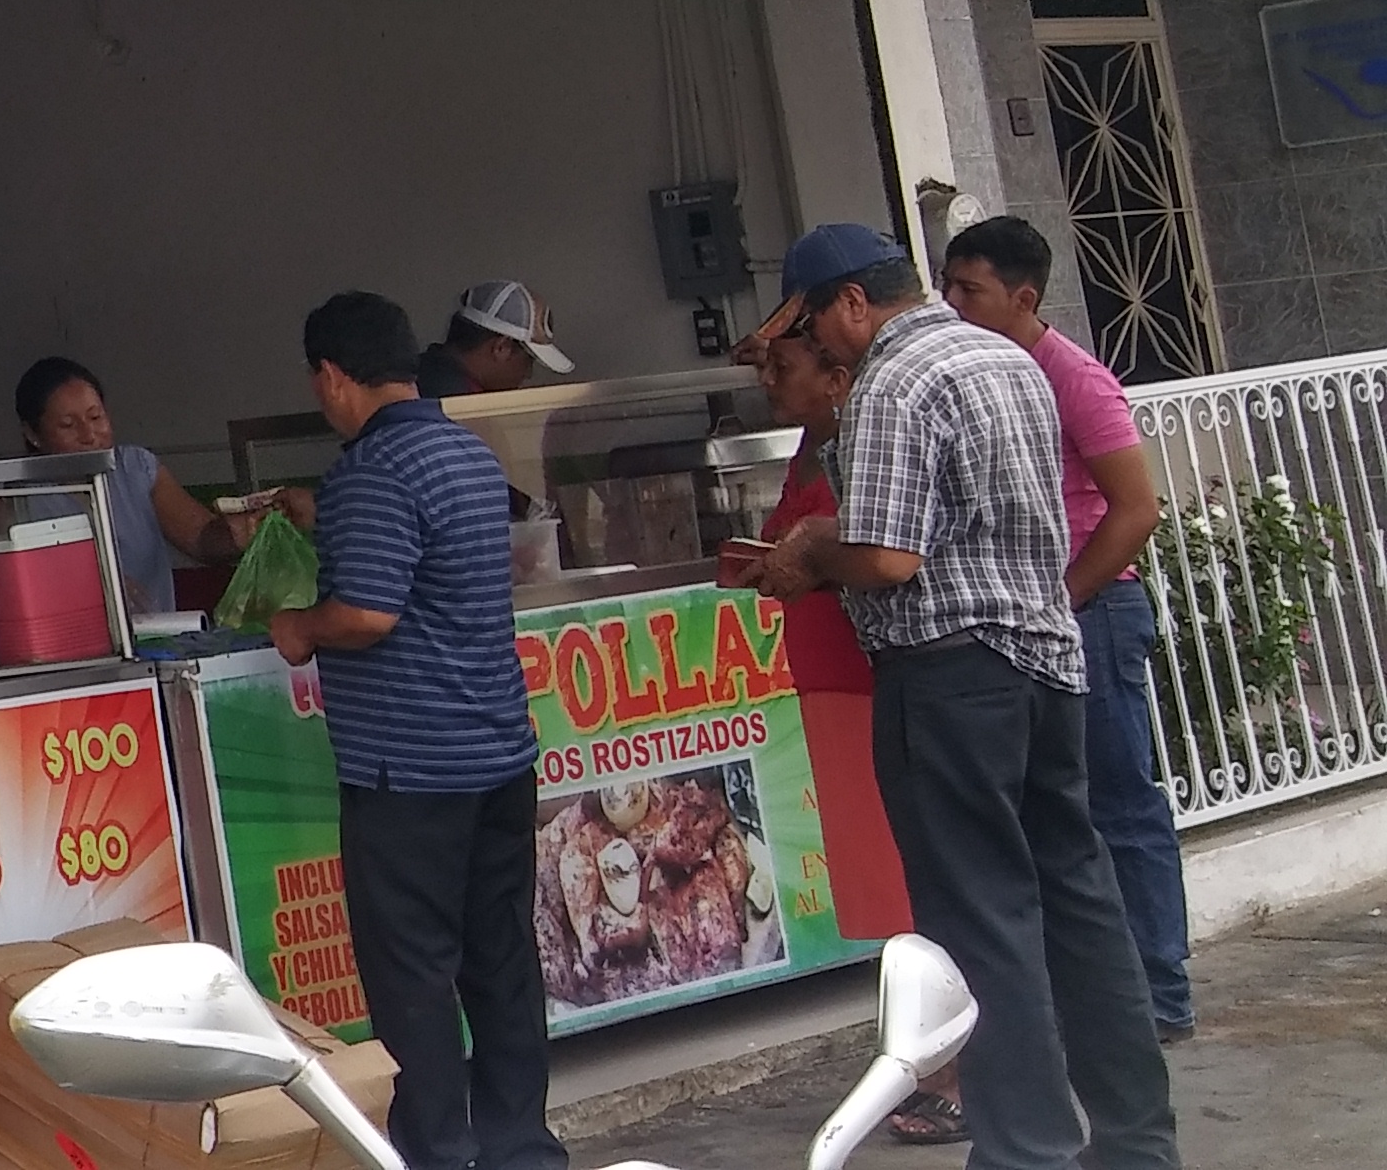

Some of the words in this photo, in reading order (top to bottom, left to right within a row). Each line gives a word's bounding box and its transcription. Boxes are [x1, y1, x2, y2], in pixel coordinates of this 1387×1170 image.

[43, 722, 139, 780] $100
[537, 747, 584, 786] OS
[593, 712, 768, 776] ROSTIZADOS
[59, 824, 129, 882] $80
[275, 900, 348, 948] SALSA
[272, 955, 287, 992] Y
